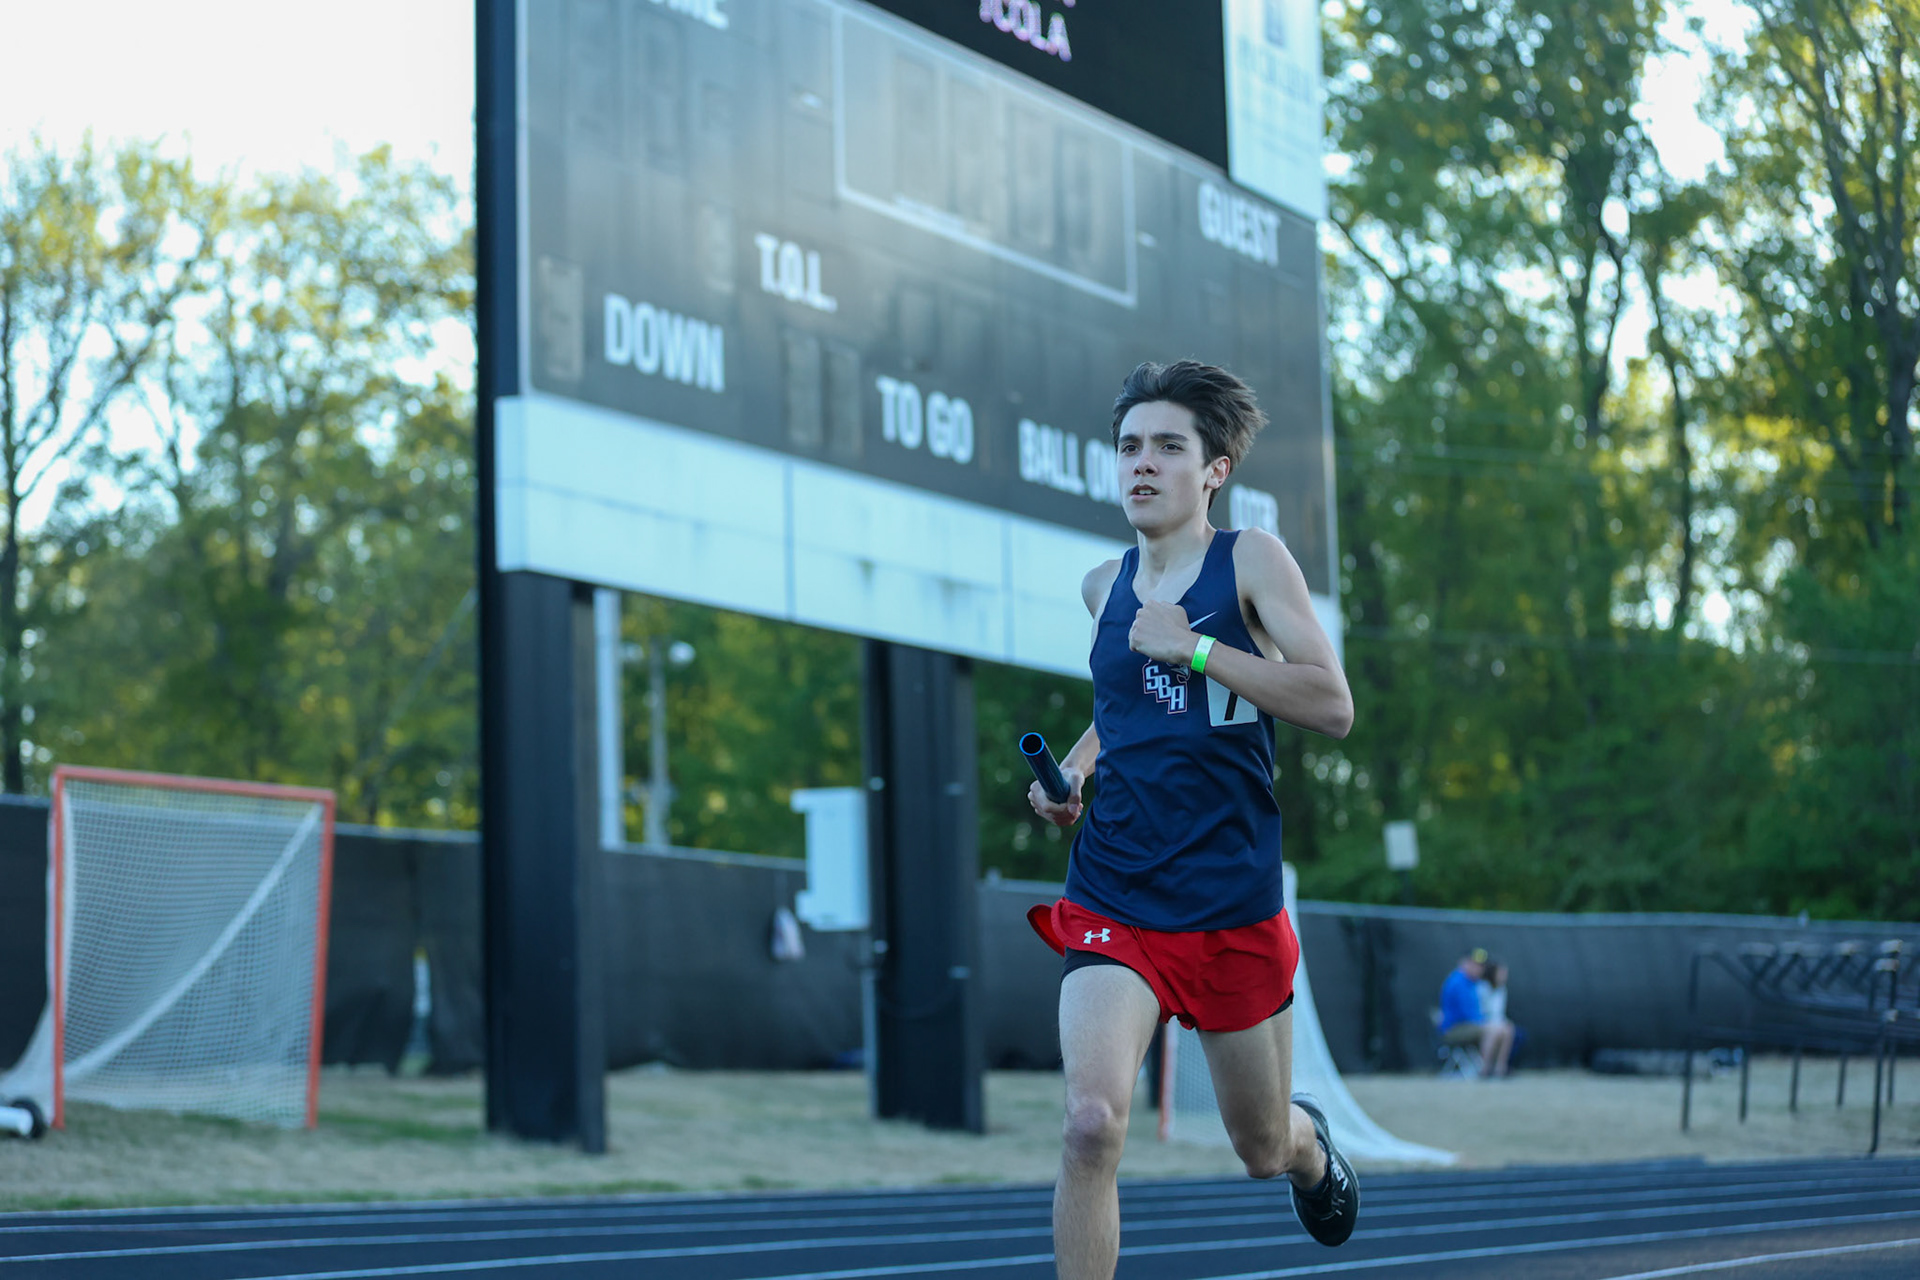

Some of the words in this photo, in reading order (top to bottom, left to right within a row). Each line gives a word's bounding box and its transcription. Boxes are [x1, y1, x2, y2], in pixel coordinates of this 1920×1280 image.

[1198, 181, 1280, 268] GUEST
[603, 292, 725, 393] DOWN
[876, 374, 923, 449] TO
[926, 391, 974, 465] GO
[1018, 418, 1085, 496] BALL
[1145, 665, 1185, 711] SBA
